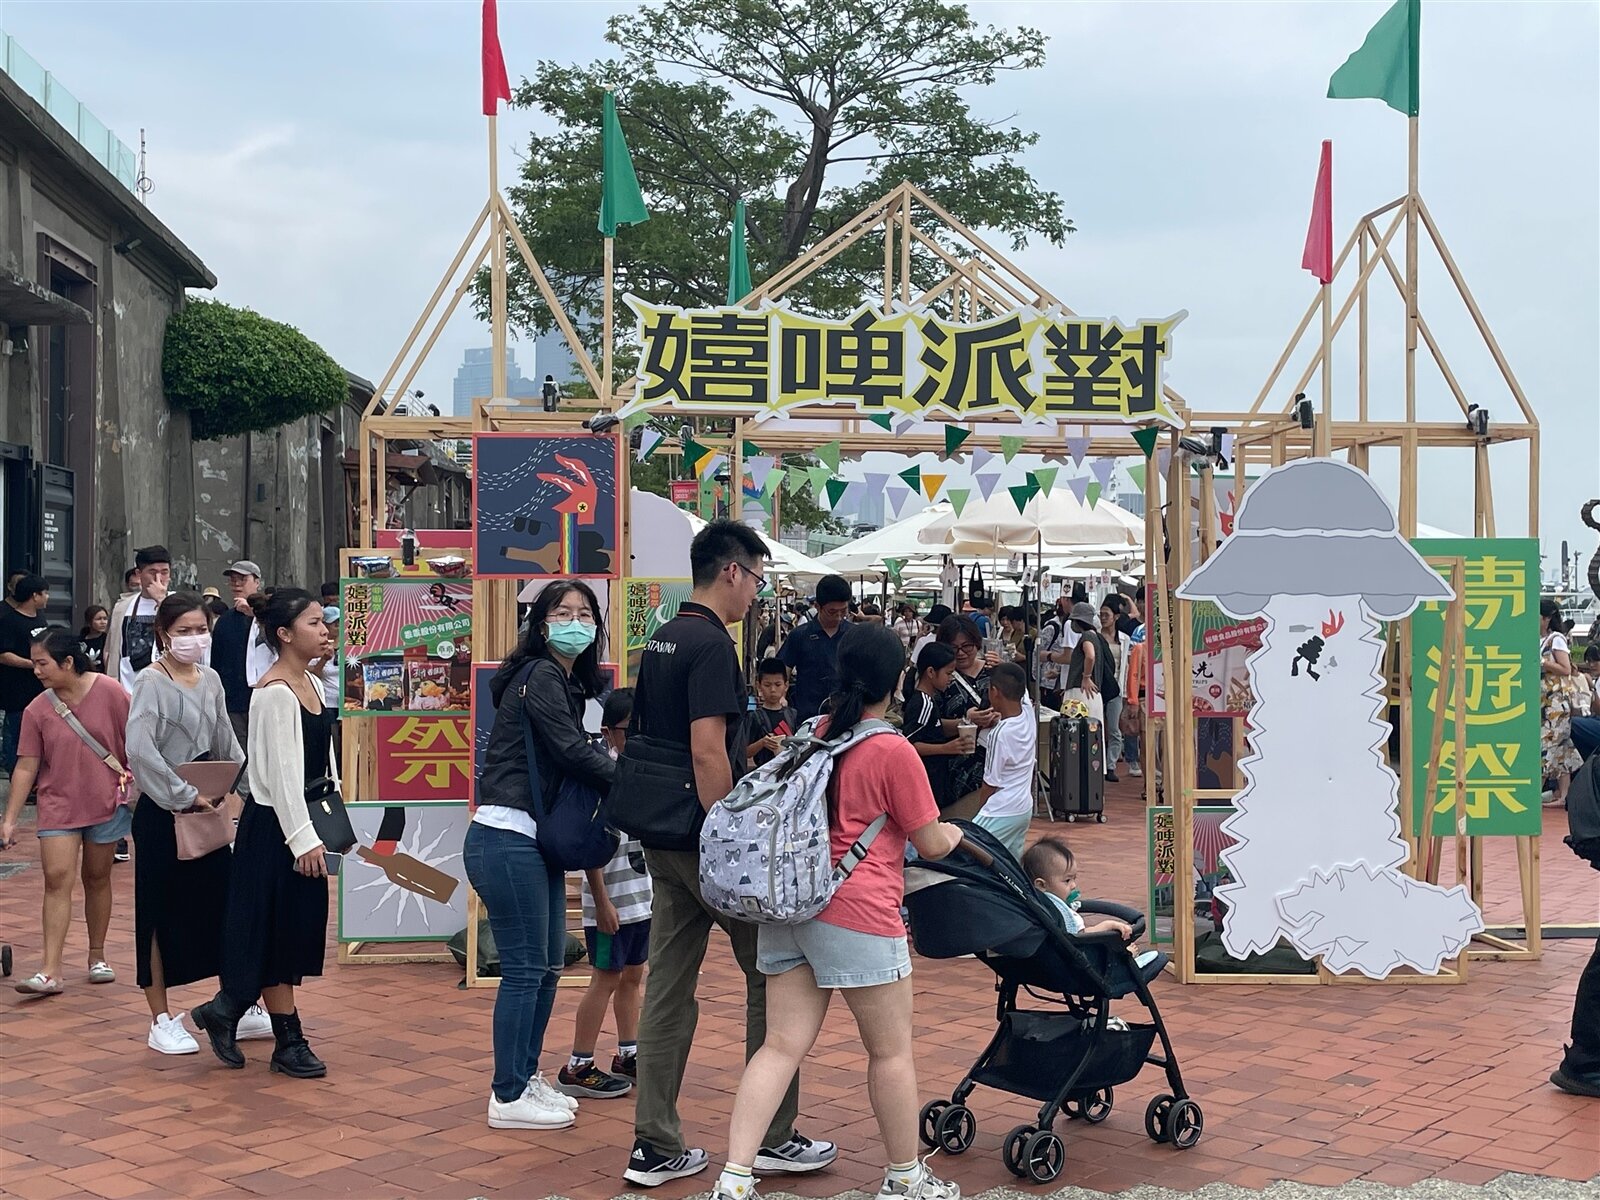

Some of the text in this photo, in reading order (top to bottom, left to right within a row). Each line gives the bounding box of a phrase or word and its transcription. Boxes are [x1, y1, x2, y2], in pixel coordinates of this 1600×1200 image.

[644, 310, 1166, 415] 嬉啤派對
[347, 585, 368, 646] 嬉啤派對
[630, 584, 646, 636] 嬉啤派對
